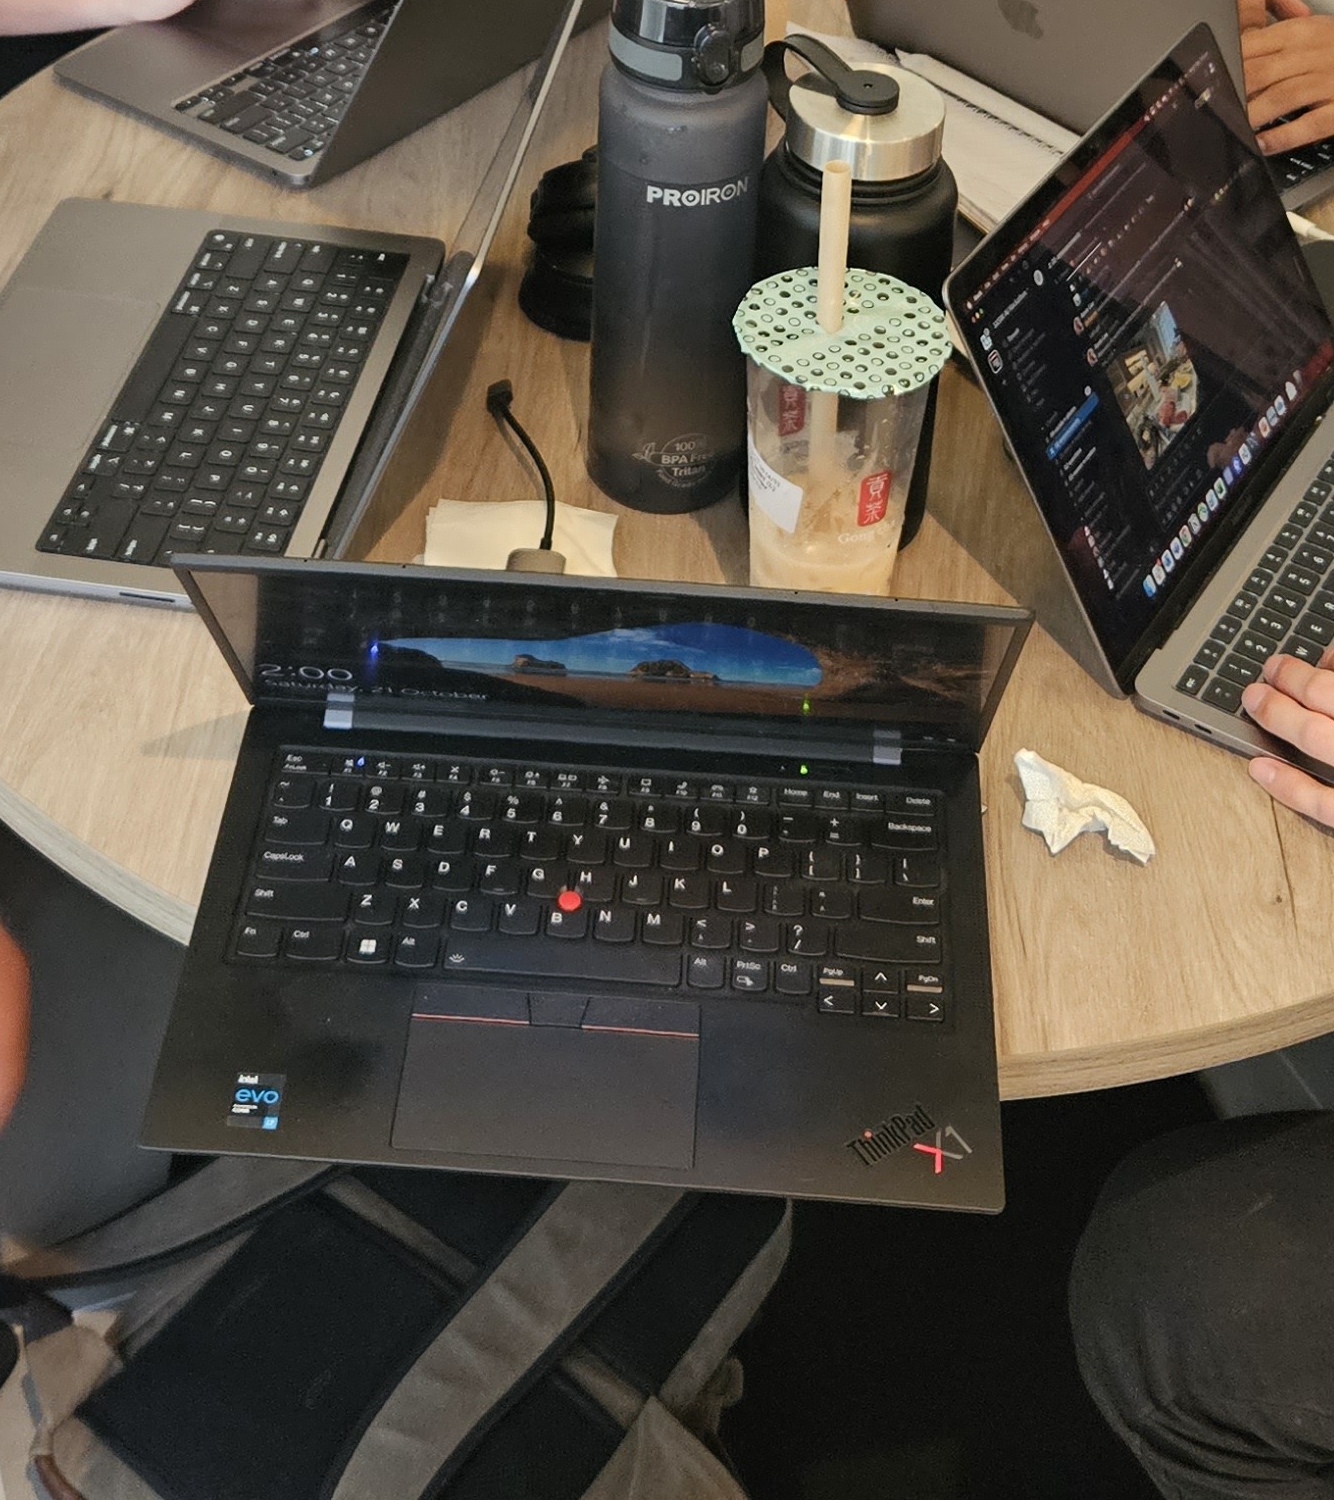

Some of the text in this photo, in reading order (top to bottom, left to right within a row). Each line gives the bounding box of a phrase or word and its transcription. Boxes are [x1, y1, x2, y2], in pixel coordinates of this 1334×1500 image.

[646, 177, 748, 207] PROIRON
[661, 454, 688, 465] BPA
[671, 465, 706, 477] Tritan
[326, 796, 331, 805] 1
[369, 799, 379, 810] 2
[415, 802, 424, 812] 3
[460, 805, 470, 815] 4
[507, 808, 516, 818] 5
[552, 811, 562, 821] 6
[599, 814, 608, 824] 7
[645, 817, 655, 828] 8
[692, 821, 701, 831] 9
[737, 824, 747, 835] 0
[341, 819, 353, 830] Q
[386, 822, 400, 833] W
[433, 825, 444, 835] E
[479, 828, 490, 839] R
[527, 831, 536, 842] T
[573, 834, 583, 845] Y
[619, 837, 630, 848] U
[669, 841, 674, 851] I
[712, 844, 723, 855] O
[758, 847, 769, 858] P
[344, 856, 355, 866] A
[392, 859, 403, 870] S
[438, 861, 450, 872] D
[486, 865, 496, 875] F
[532, 868, 544, 880] G
[580, 871, 592, 882] H
[629, 875, 637, 886] J
[674, 878, 685, 889] K
[723, 881, 731, 892] L
[361, 894, 372, 906] Z
[409, 898, 420, 909] X
[456, 900, 468, 912] C
[505, 904, 516, 915] V
[551, 912, 562, 923] B
[599, 910, 611, 922] N
[647, 913, 660, 925] M
[793, 925, 803, 935] ?
[235, 1088, 280, 1104] evo
[846, 1103, 936, 1166] ThinkPad
